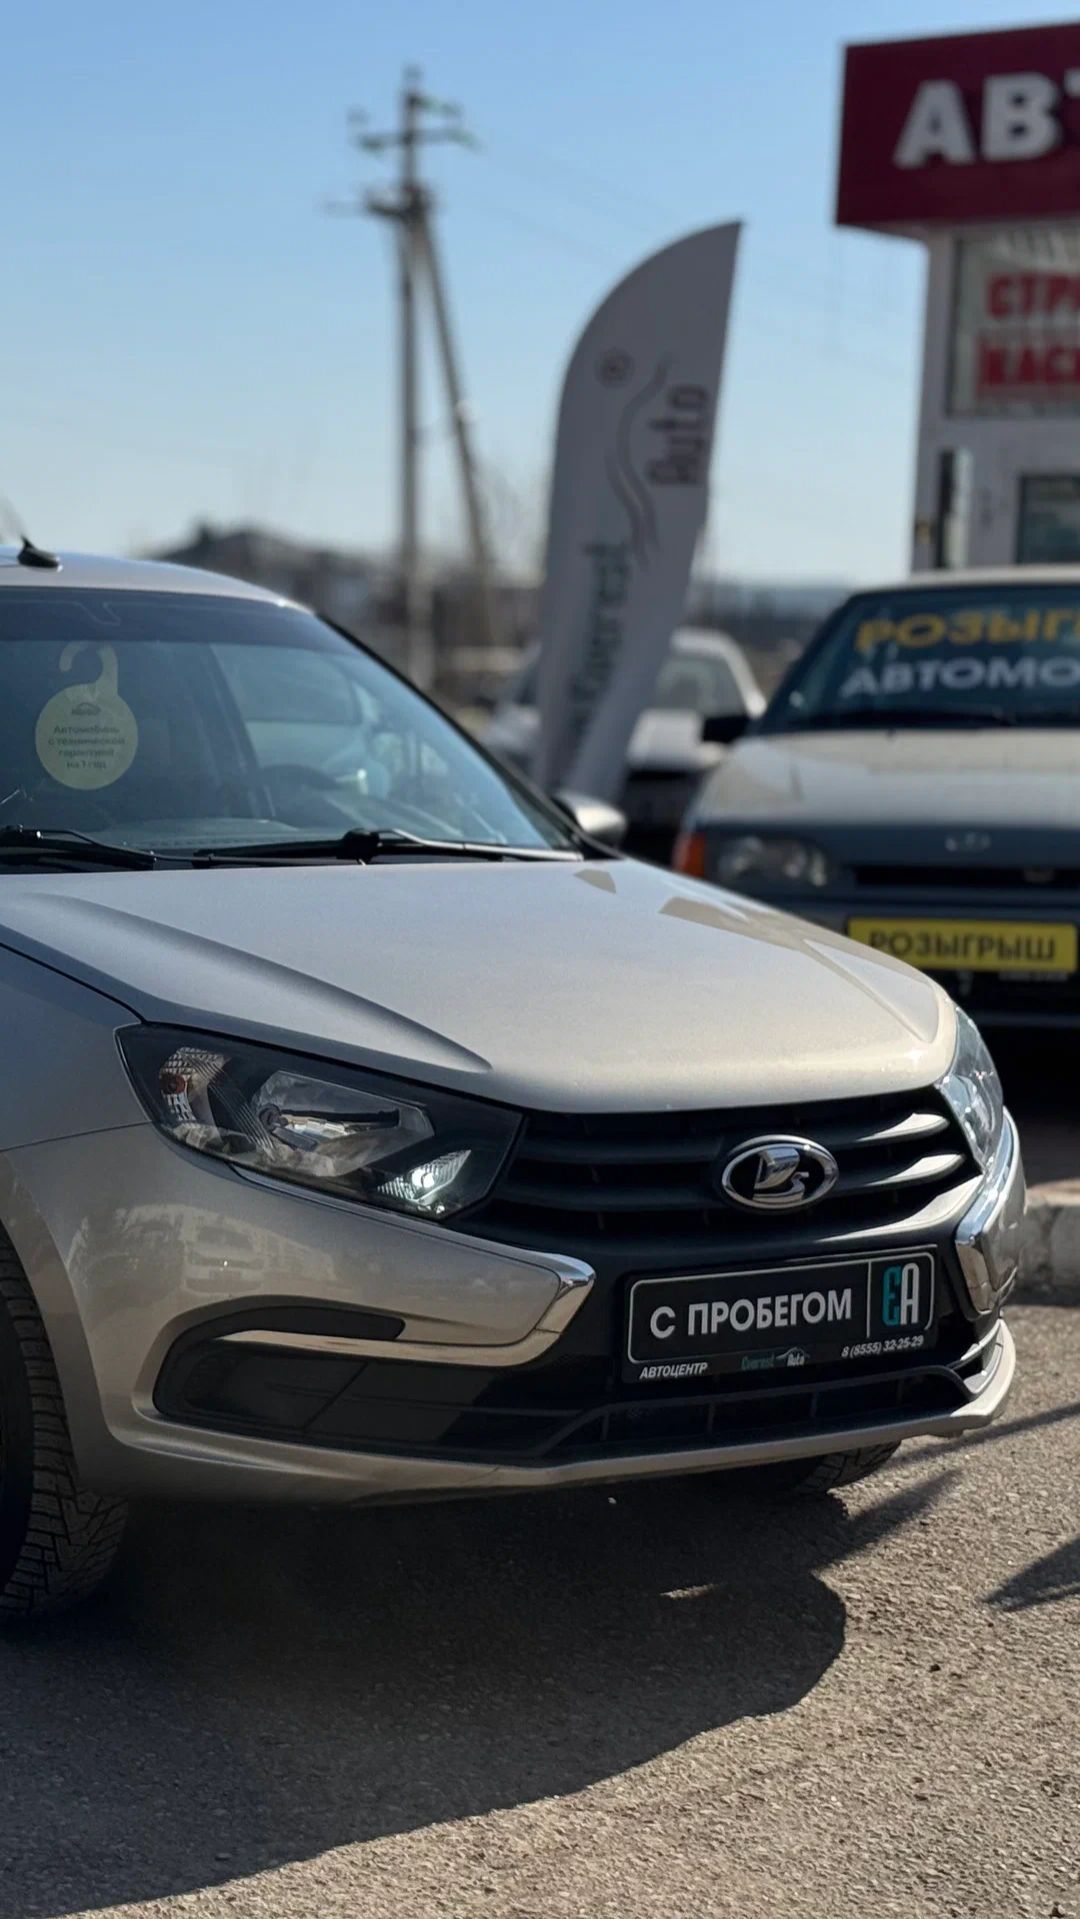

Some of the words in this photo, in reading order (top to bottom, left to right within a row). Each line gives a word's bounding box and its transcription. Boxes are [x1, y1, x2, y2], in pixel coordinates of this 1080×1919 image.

[854, 608, 1080, 652] РОЗЫГ
[868, 928, 1056, 961] РОЗЫГРЫШ
[650, 1306, 676, 1338] С
[688, 1288, 852, 1336] ПРОБЕГОМ
[841, 1346, 850, 1358] 8
[883, 1334, 925, 1352] 32-25-29
[639, 1362, 708, 1379] АВТОЦЕНТР
